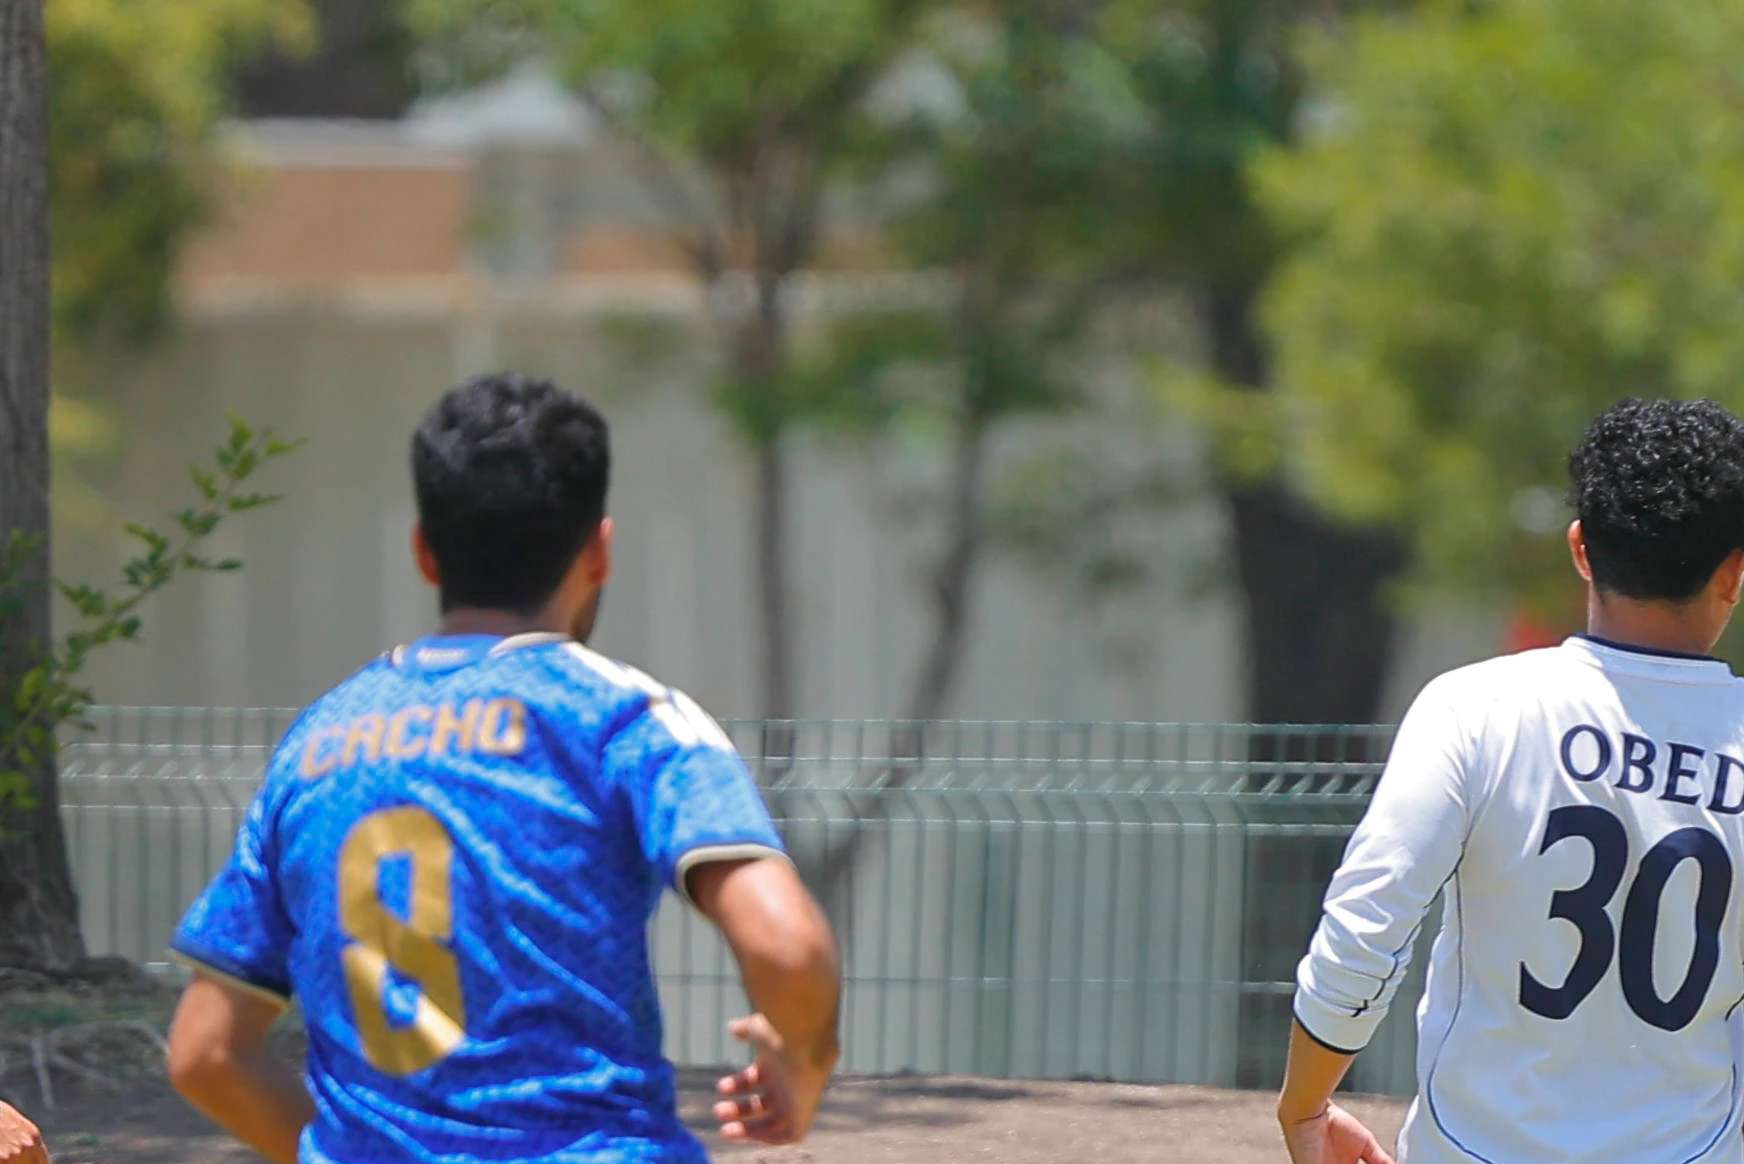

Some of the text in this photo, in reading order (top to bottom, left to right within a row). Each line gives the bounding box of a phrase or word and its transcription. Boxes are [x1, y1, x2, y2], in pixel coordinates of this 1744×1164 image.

[302, 697, 524, 778] CACHO
[338, 804, 466, 1076] 8
[1519, 804, 1733, 1032] 30
